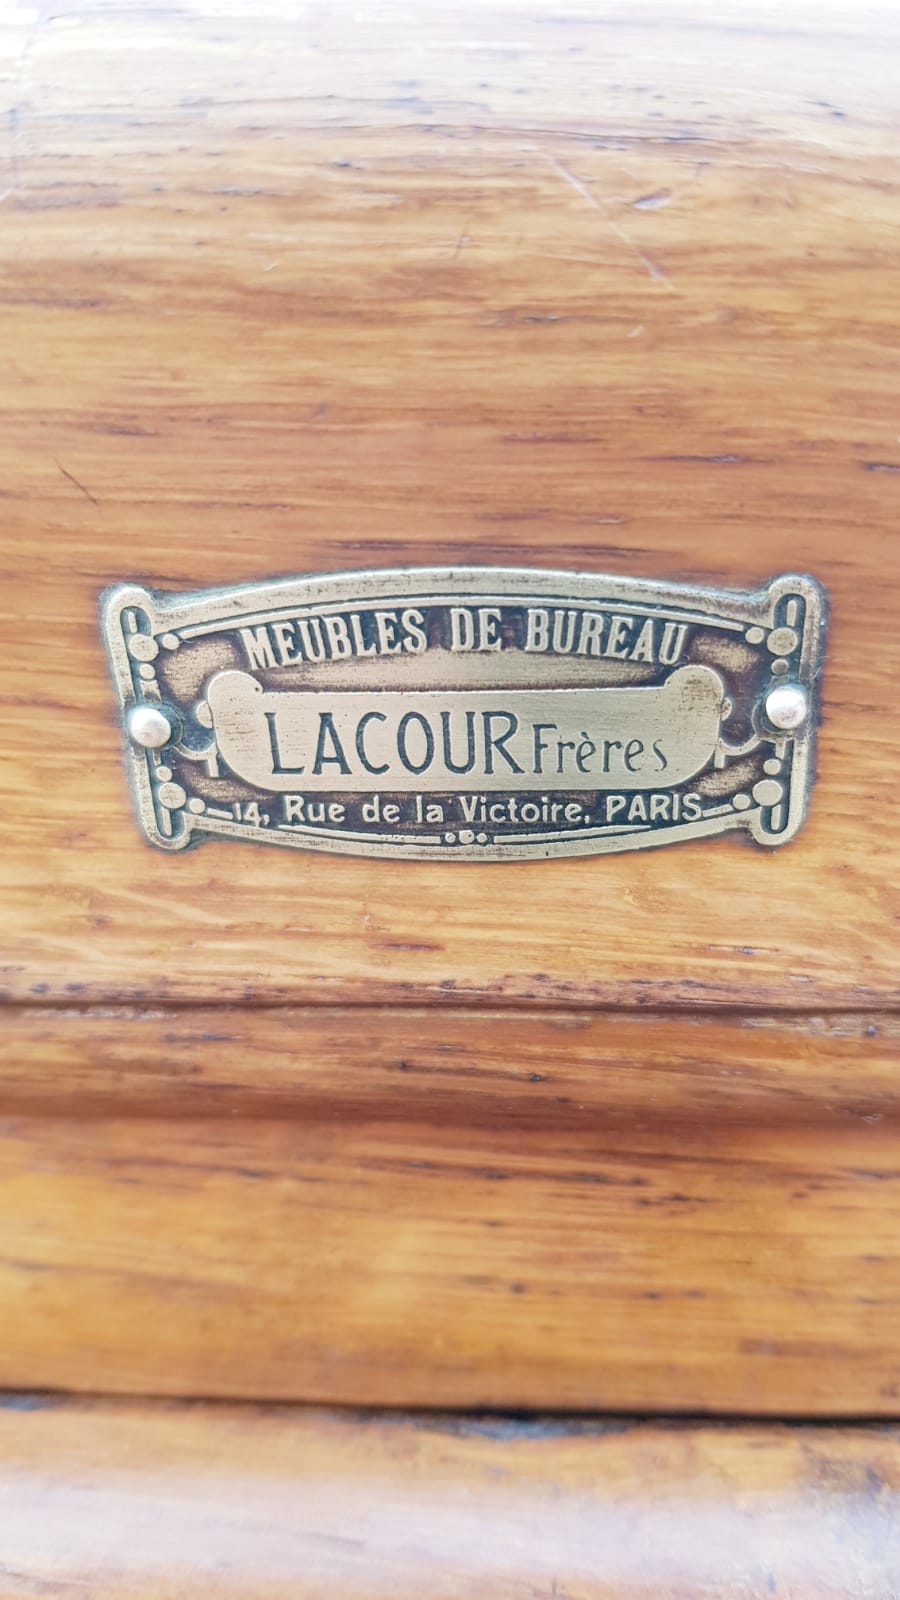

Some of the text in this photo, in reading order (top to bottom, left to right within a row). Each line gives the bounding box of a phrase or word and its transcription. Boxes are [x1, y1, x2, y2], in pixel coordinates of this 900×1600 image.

[240, 608, 688, 670] MEUBLES DE BUREAU
[264, 710, 668, 775] LACOUR Frères
[233, 802, 270, 828] 14,
[284, 795, 345, 822] Rue
[362, 795, 400, 823] de
[417, 795, 444, 823] la
[606, 793, 703, 821] PARIS
